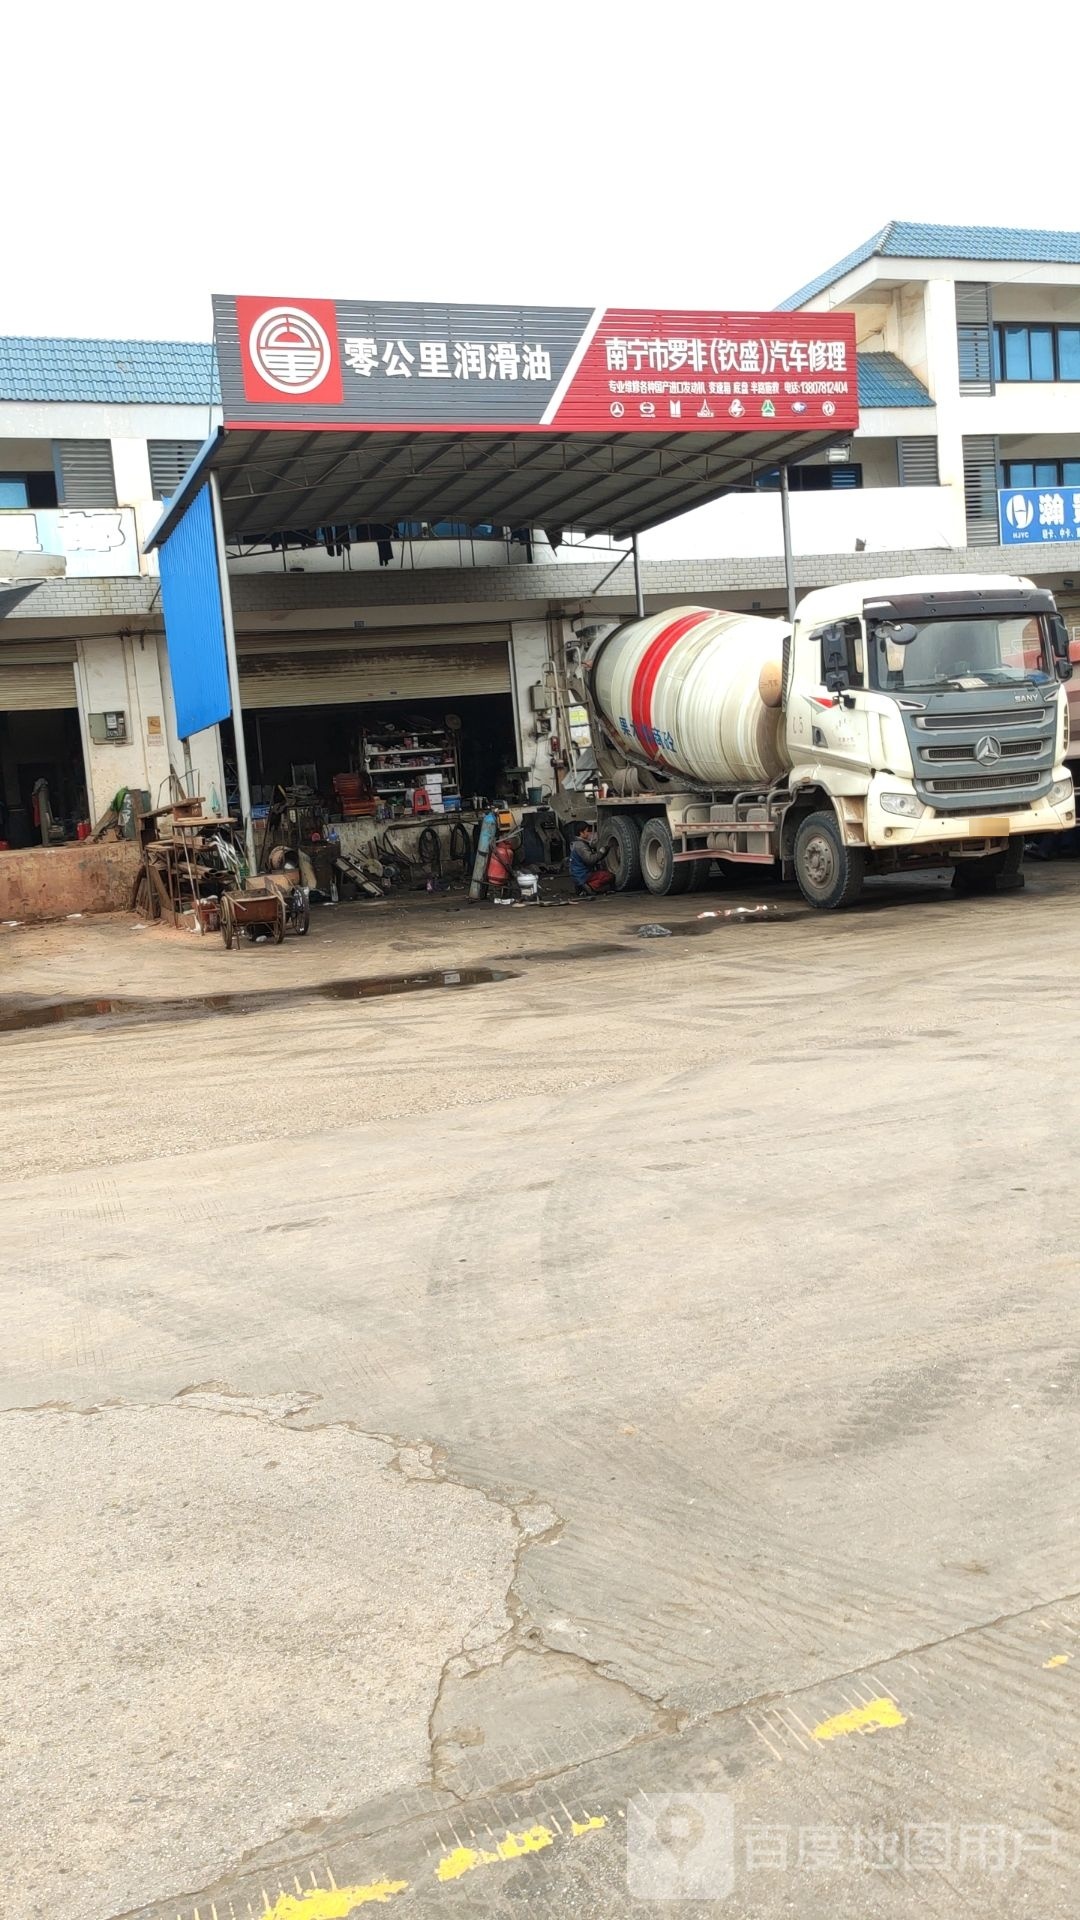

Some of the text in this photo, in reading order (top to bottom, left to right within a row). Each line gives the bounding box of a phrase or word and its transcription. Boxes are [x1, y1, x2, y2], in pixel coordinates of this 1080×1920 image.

[344, 338, 552, 381] 零公里润滑油
[605, 337, 847, 374] 南宁市罗非(钦盛)汽车修理
[1038, 493, 1080, 525] 瀚
[1014, 694, 1038, 702] SANY
